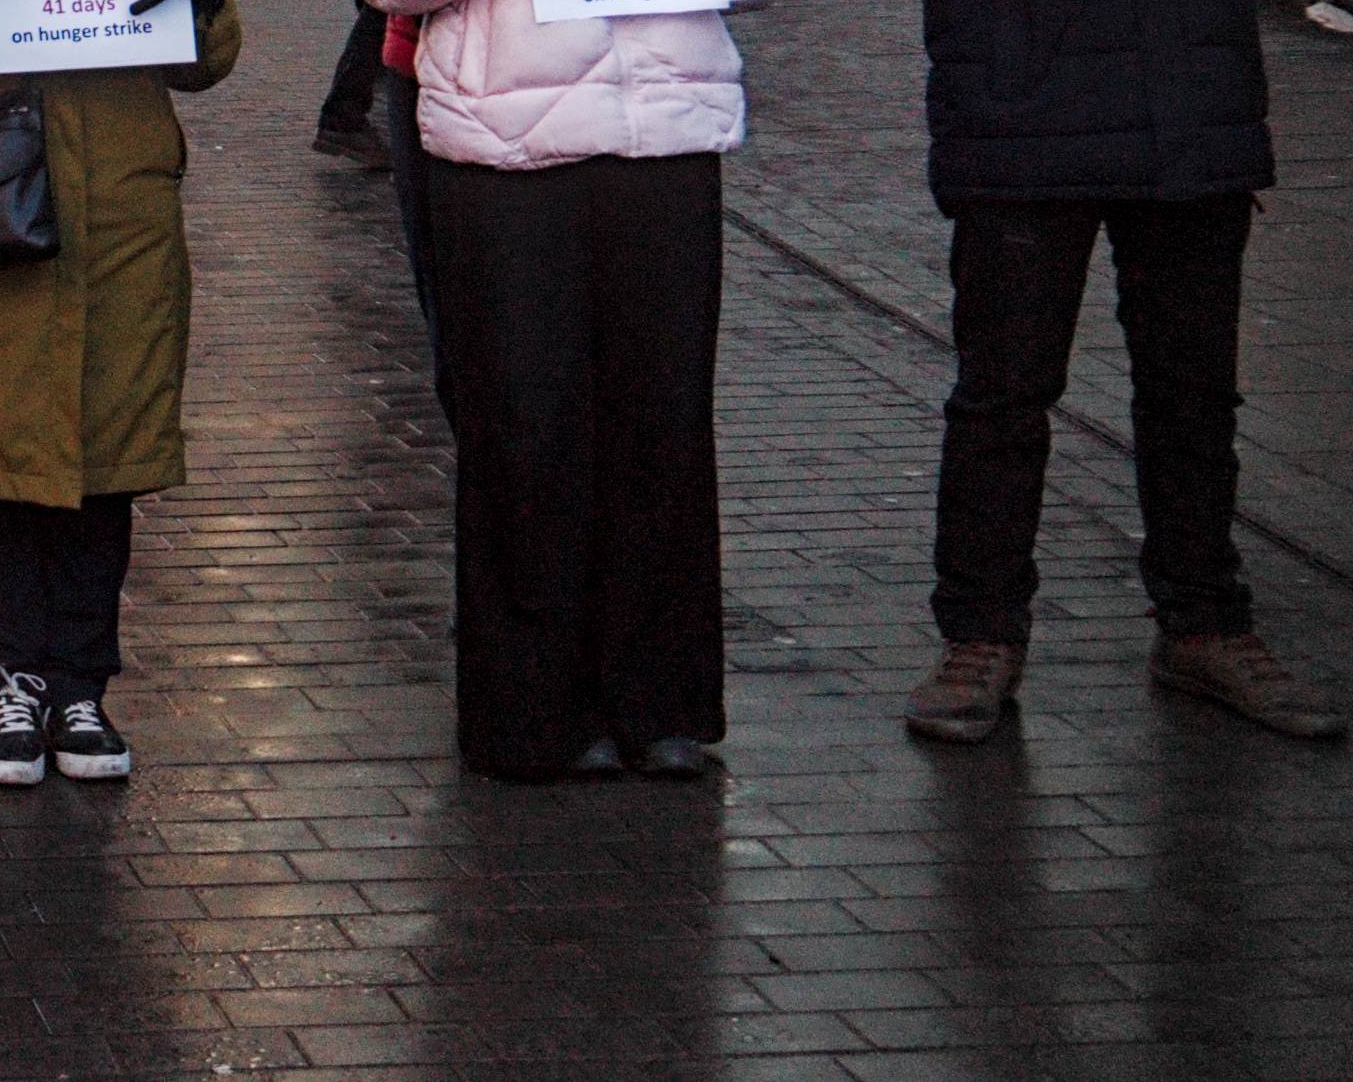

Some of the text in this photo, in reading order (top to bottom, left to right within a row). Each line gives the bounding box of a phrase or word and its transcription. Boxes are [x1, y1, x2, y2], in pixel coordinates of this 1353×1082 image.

[42, 0, 66, 15] 41
[11, 19, 153, 44] on hunger strike
